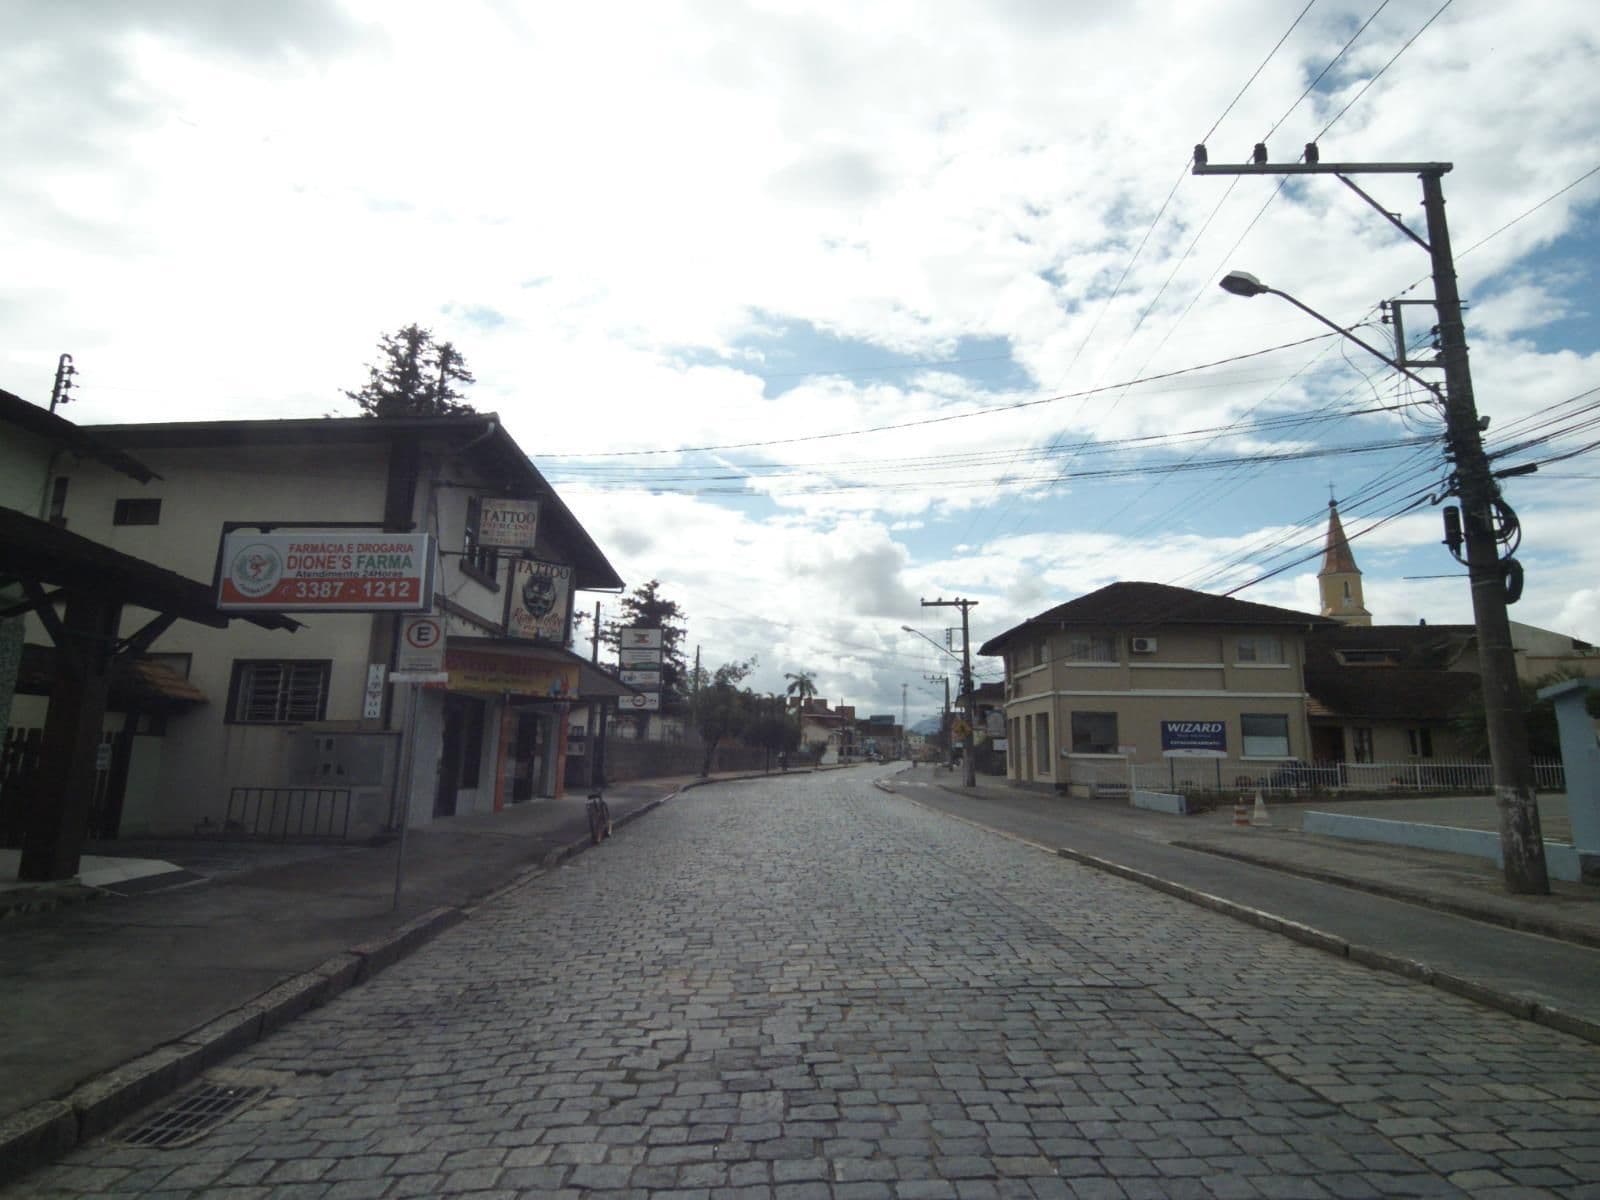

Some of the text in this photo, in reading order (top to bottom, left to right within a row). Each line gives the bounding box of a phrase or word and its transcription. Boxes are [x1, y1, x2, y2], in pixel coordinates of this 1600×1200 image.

[482, 510, 536, 523] TATTOO
[347, 543, 354, 553] E
[357, 543, 414, 553] DROGARIA
[286, 555, 412, 569] DIONE'S FARMA
[296, 570, 359, 578] Atendimento
[518, 560, 569, 579] TATTOO
[296, 582, 344, 597] 3387
[364, 581, 410, 597] 1212
[417, 626, 431, 641] E
[1167, 723, 1222, 733] WIZARD
